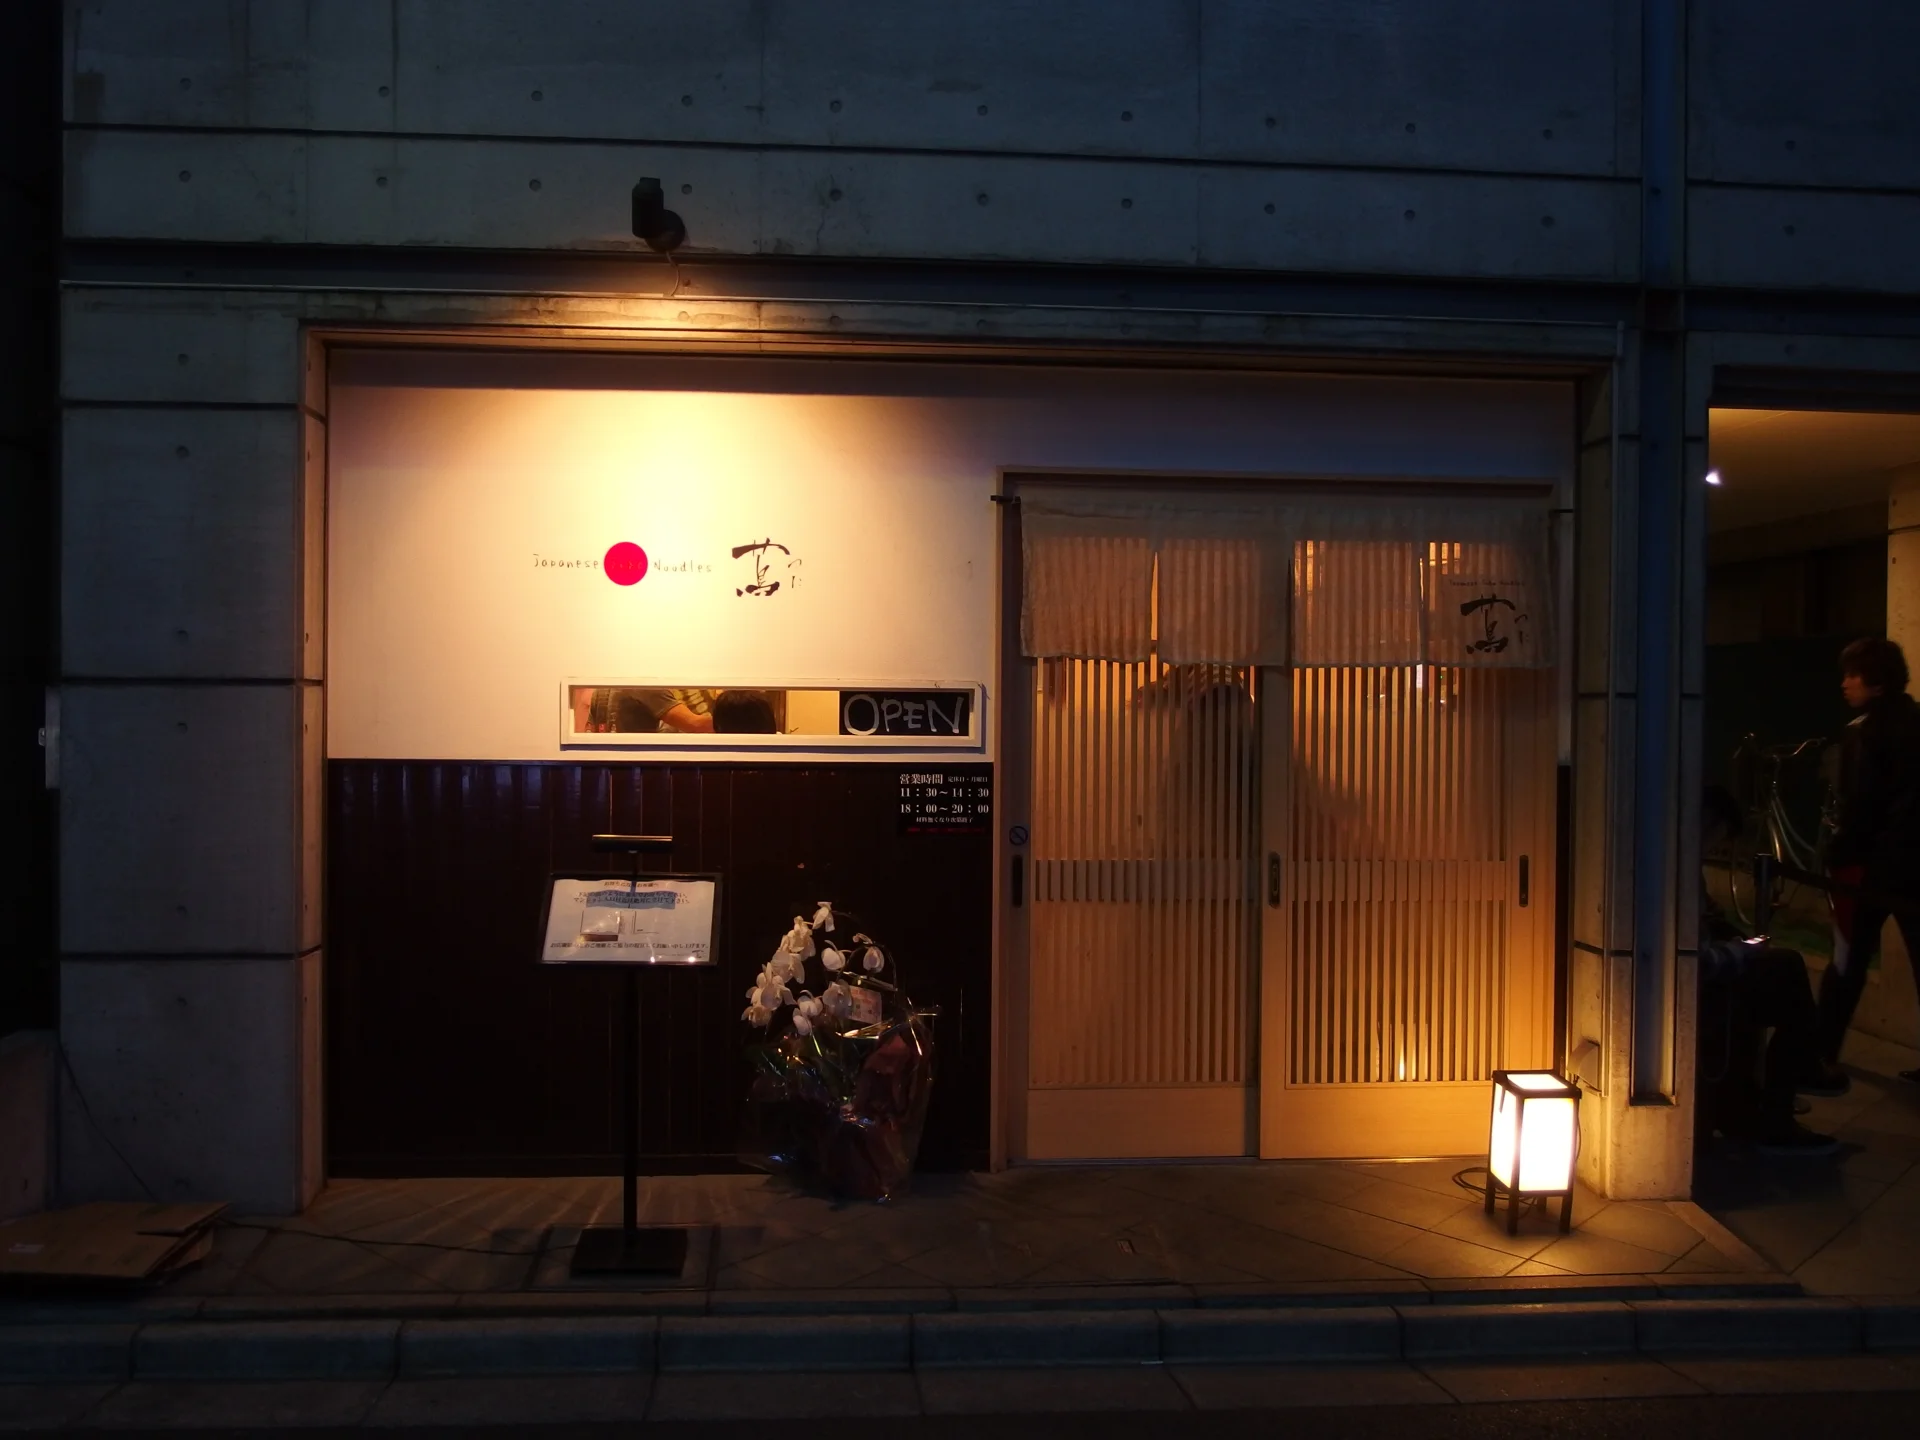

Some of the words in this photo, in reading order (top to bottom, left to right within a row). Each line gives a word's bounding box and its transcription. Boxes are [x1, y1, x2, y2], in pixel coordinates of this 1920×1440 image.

[533, 553, 599, 569] Japanese
[654, 559, 713, 573] Noodles
[843, 693, 964, 737] OPEN
[900, 773, 943, 785] 営業時間
